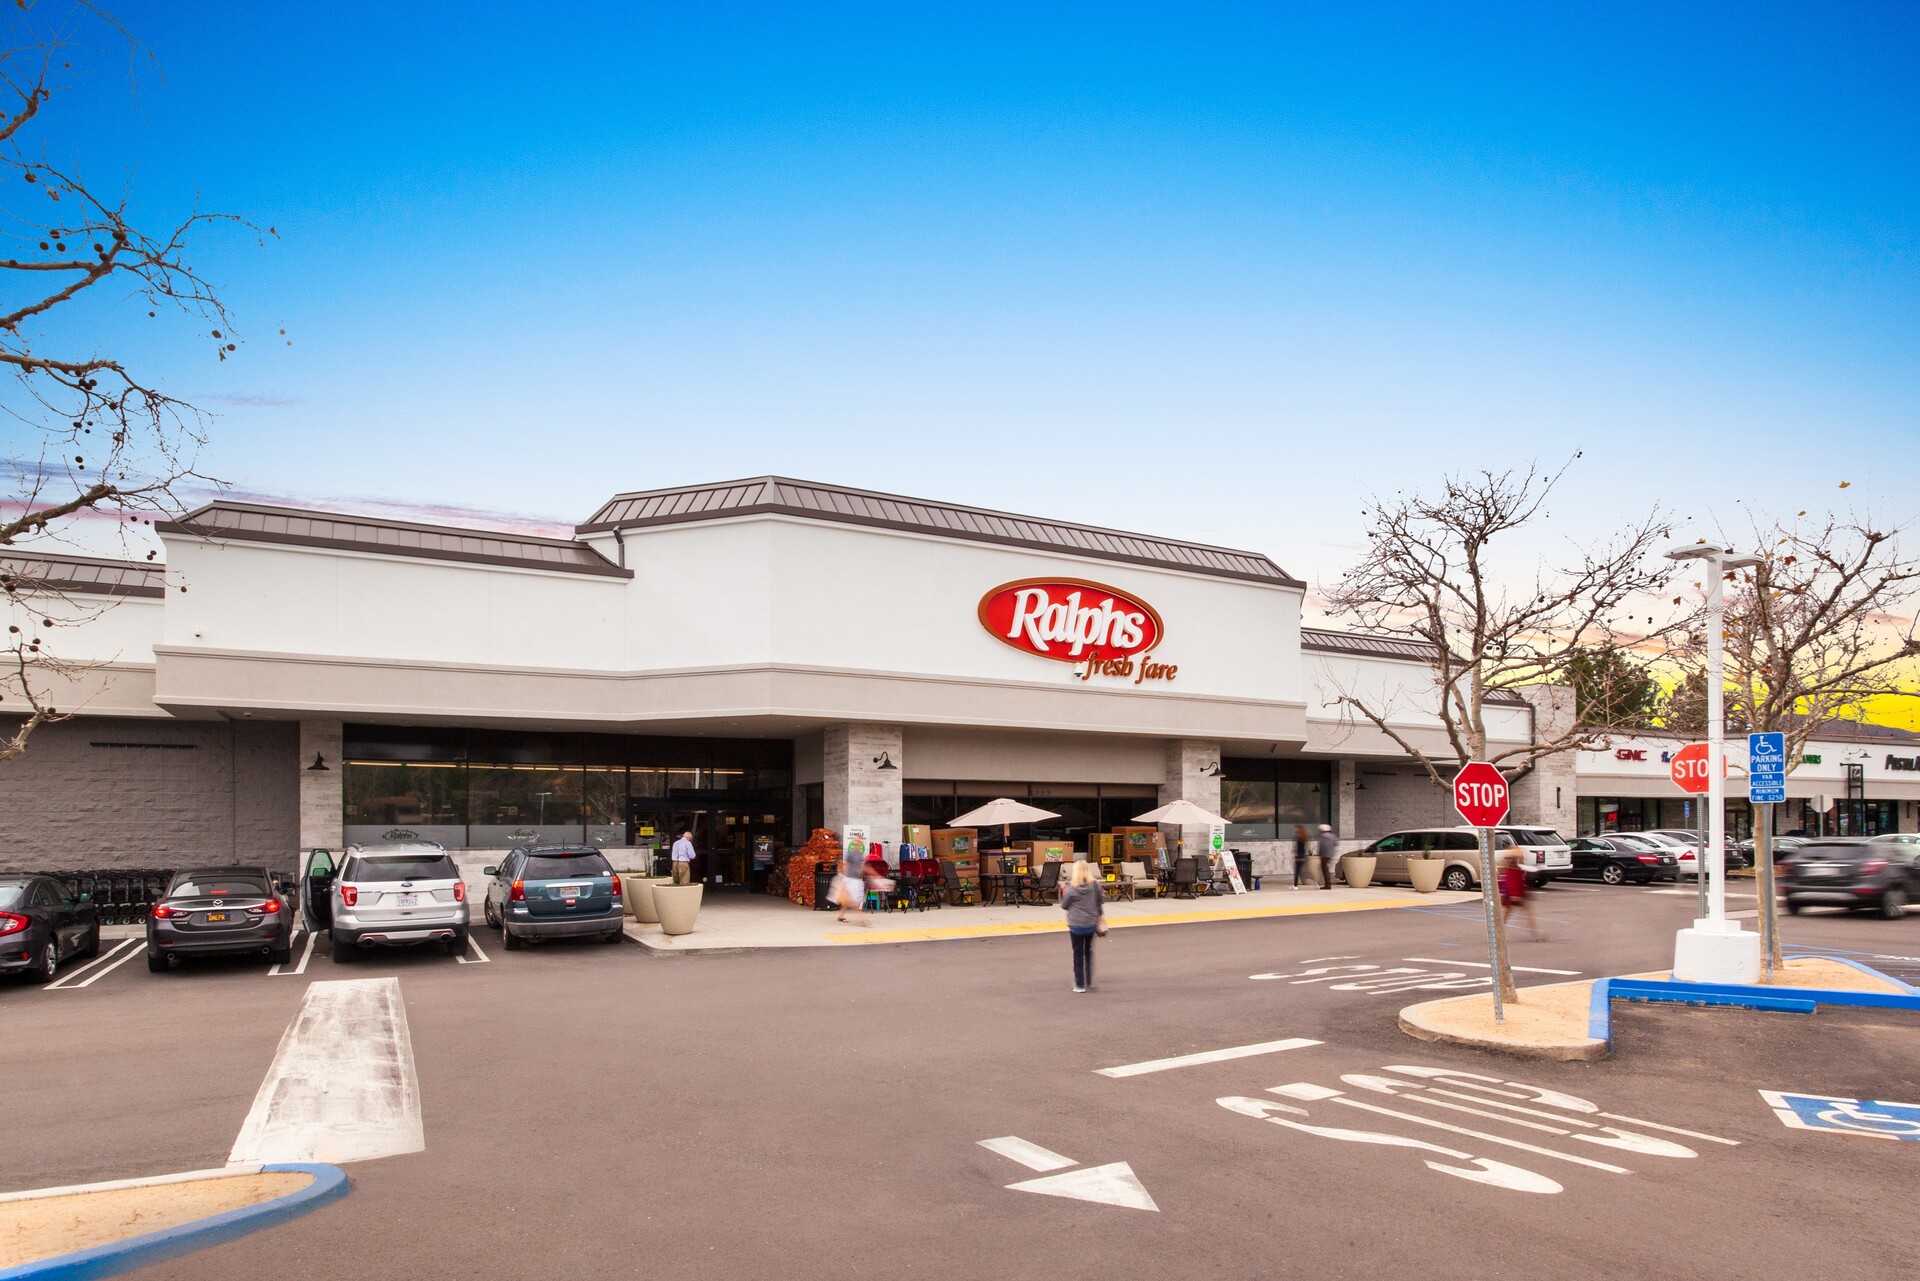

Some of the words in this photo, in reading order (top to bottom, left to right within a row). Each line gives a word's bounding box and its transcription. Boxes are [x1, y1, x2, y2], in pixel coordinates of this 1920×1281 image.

[1007, 588, 1145, 656] Ralphs
[1082, 651, 1134, 681] fresh
[1134, 655, 1179, 684] fare
[1615, 748, 1647, 761] GNC
[1751, 754, 1782, 763] PARKING
[1674, 758, 1709, 779] STO
[1757, 763, 1776, 772] ONLY
[1458, 782, 1505, 808] STOP
[1215, 1065, 1741, 1195] STOP
